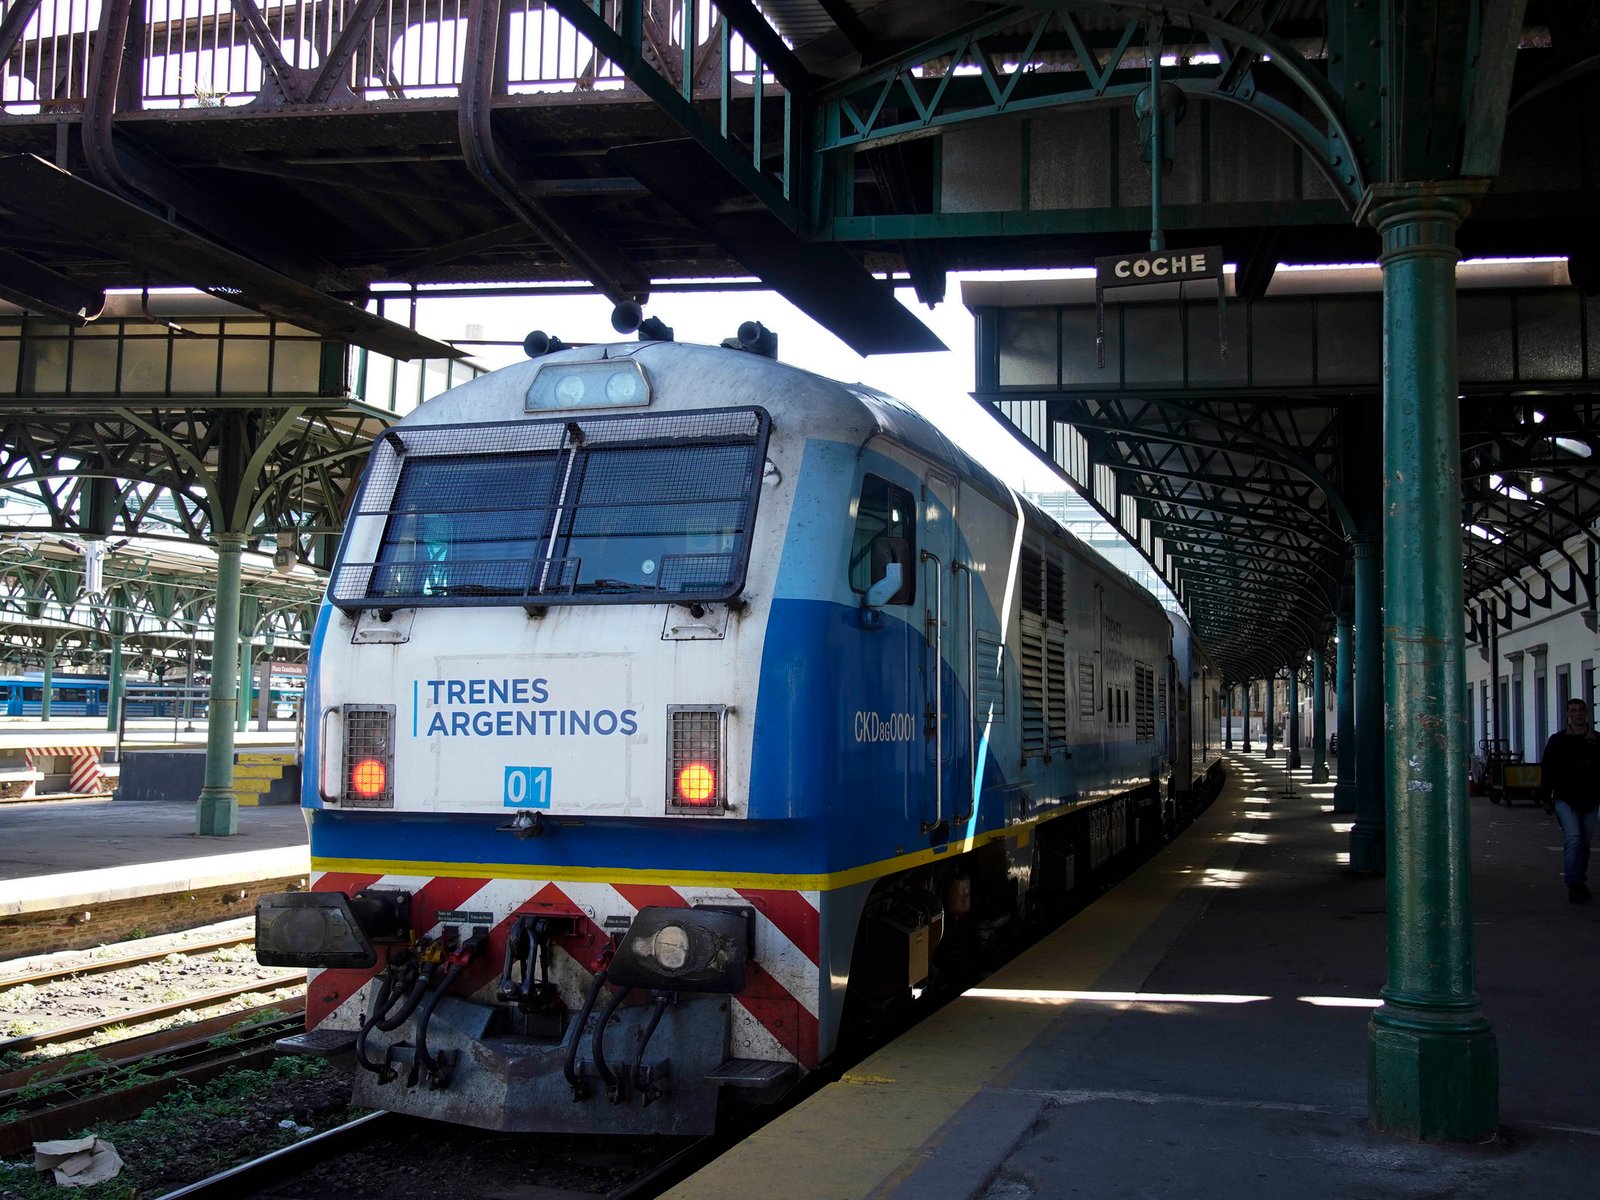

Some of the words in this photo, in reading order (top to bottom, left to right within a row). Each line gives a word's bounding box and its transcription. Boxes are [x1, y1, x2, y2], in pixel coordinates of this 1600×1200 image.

[1114, 254, 1206, 278] COCHE
[427, 678, 549, 705] TRENES
[427, 709, 638, 736] ARGENTINOS
[854, 711, 915, 742] CKD8G0001
[507, 769, 548, 803] 01
